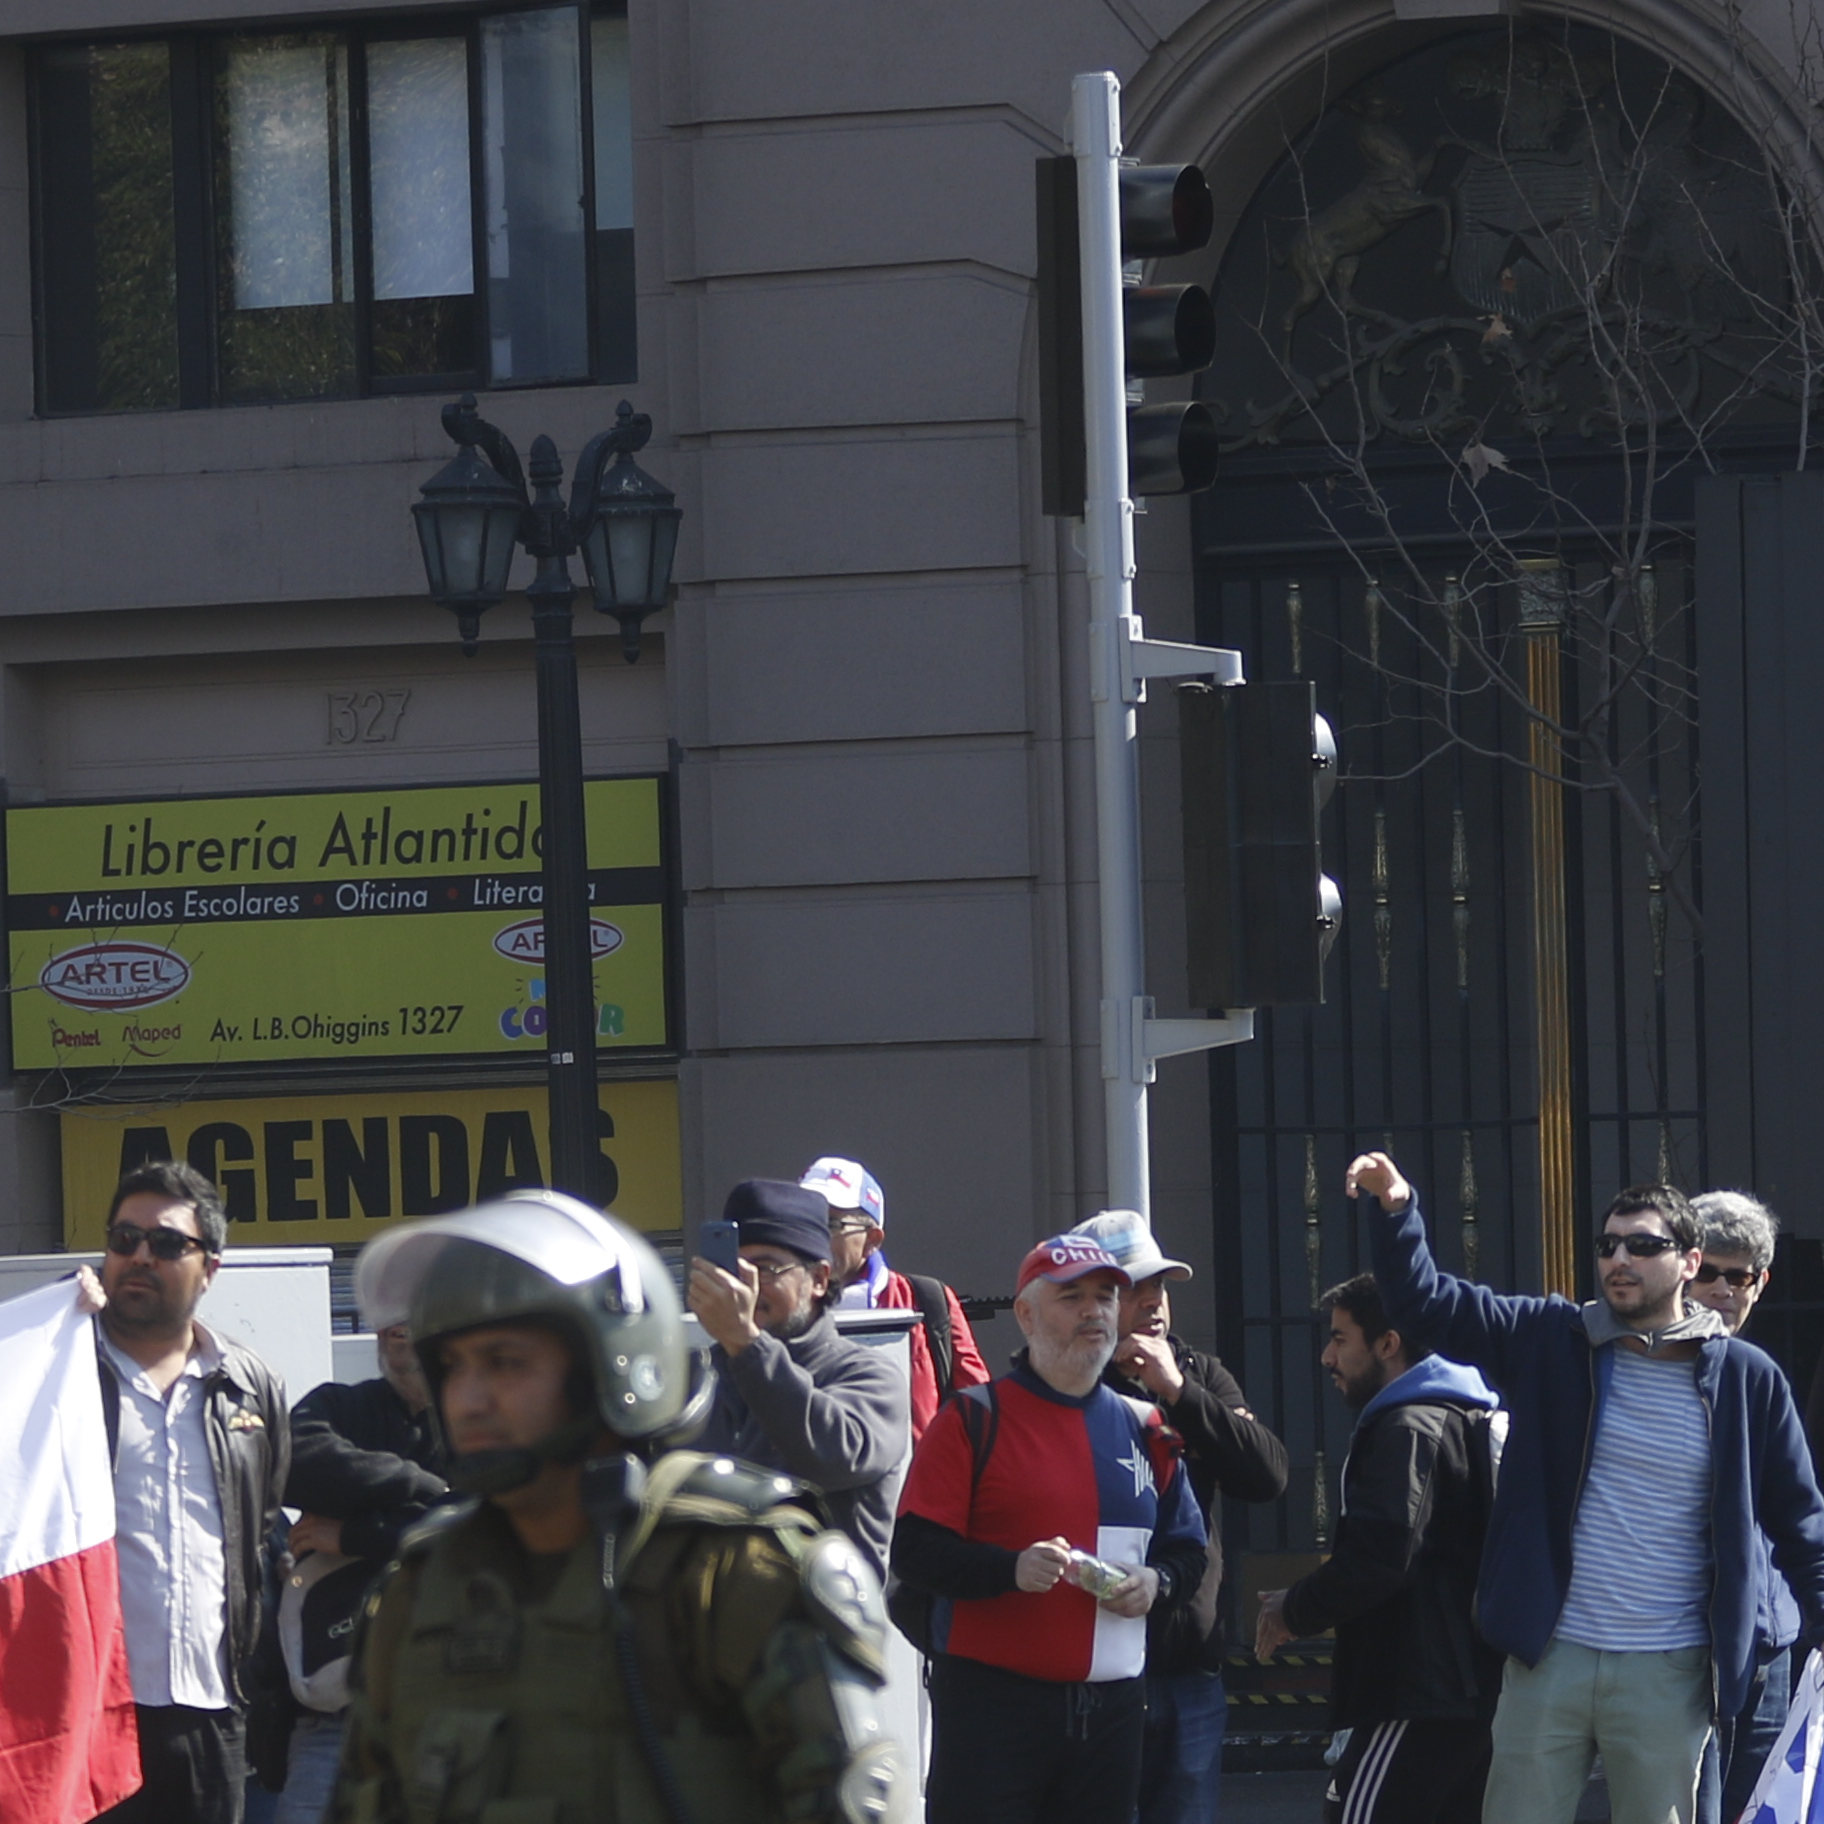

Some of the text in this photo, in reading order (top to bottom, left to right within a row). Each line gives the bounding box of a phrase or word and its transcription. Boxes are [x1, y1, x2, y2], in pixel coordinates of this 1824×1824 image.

[325, 688, 413, 746] 1327
[102, 817, 297, 878] Librería
[65, 890, 174, 923] Articulos
[183, 886, 300, 918] Escolares
[335, 881, 428, 911] Oficina
[60, 960, 172, 986] ARTEL
[52, 1023, 183, 1048] Pentel Maped
[210, 1017, 244, 1043] Av.
[398, 1004, 465, 1036] 1327
